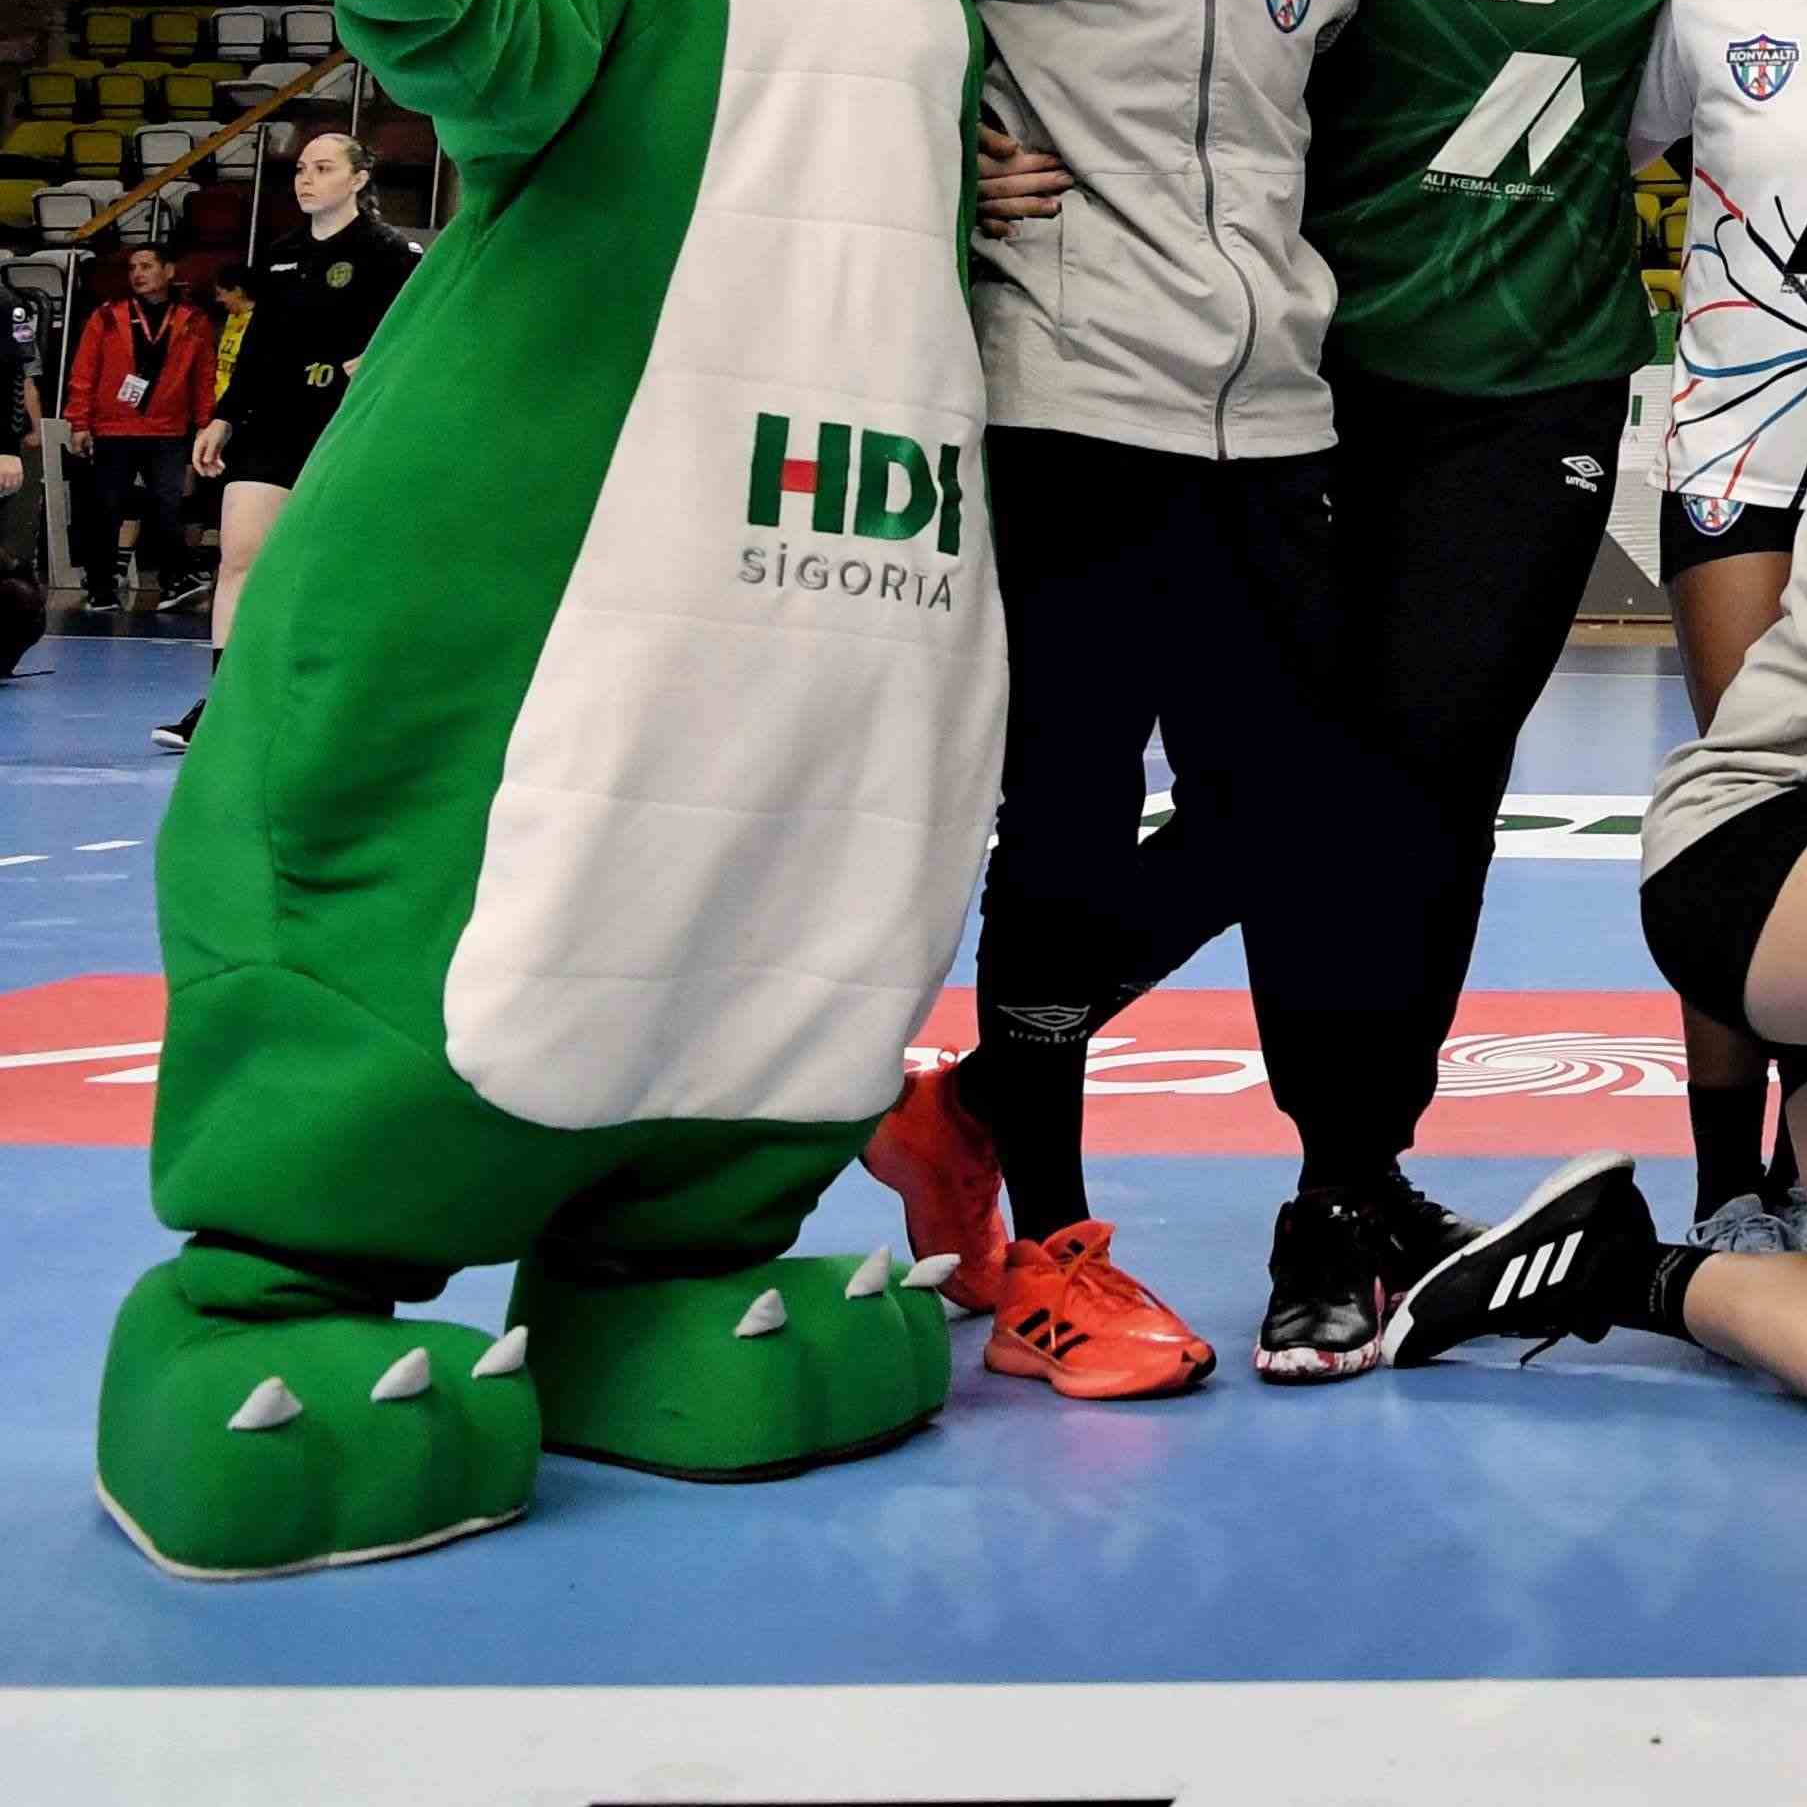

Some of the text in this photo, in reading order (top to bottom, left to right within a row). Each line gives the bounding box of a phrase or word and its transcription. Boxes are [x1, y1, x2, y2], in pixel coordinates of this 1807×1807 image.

[1729, 49, 1796, 62] KONYAALTI
[1449, 176, 1501, 193] KEMAL
[304, 361, 334, 388] 10
[747, 411, 963, 557] HDI
[739, 543, 952, 612] SİGORTA
